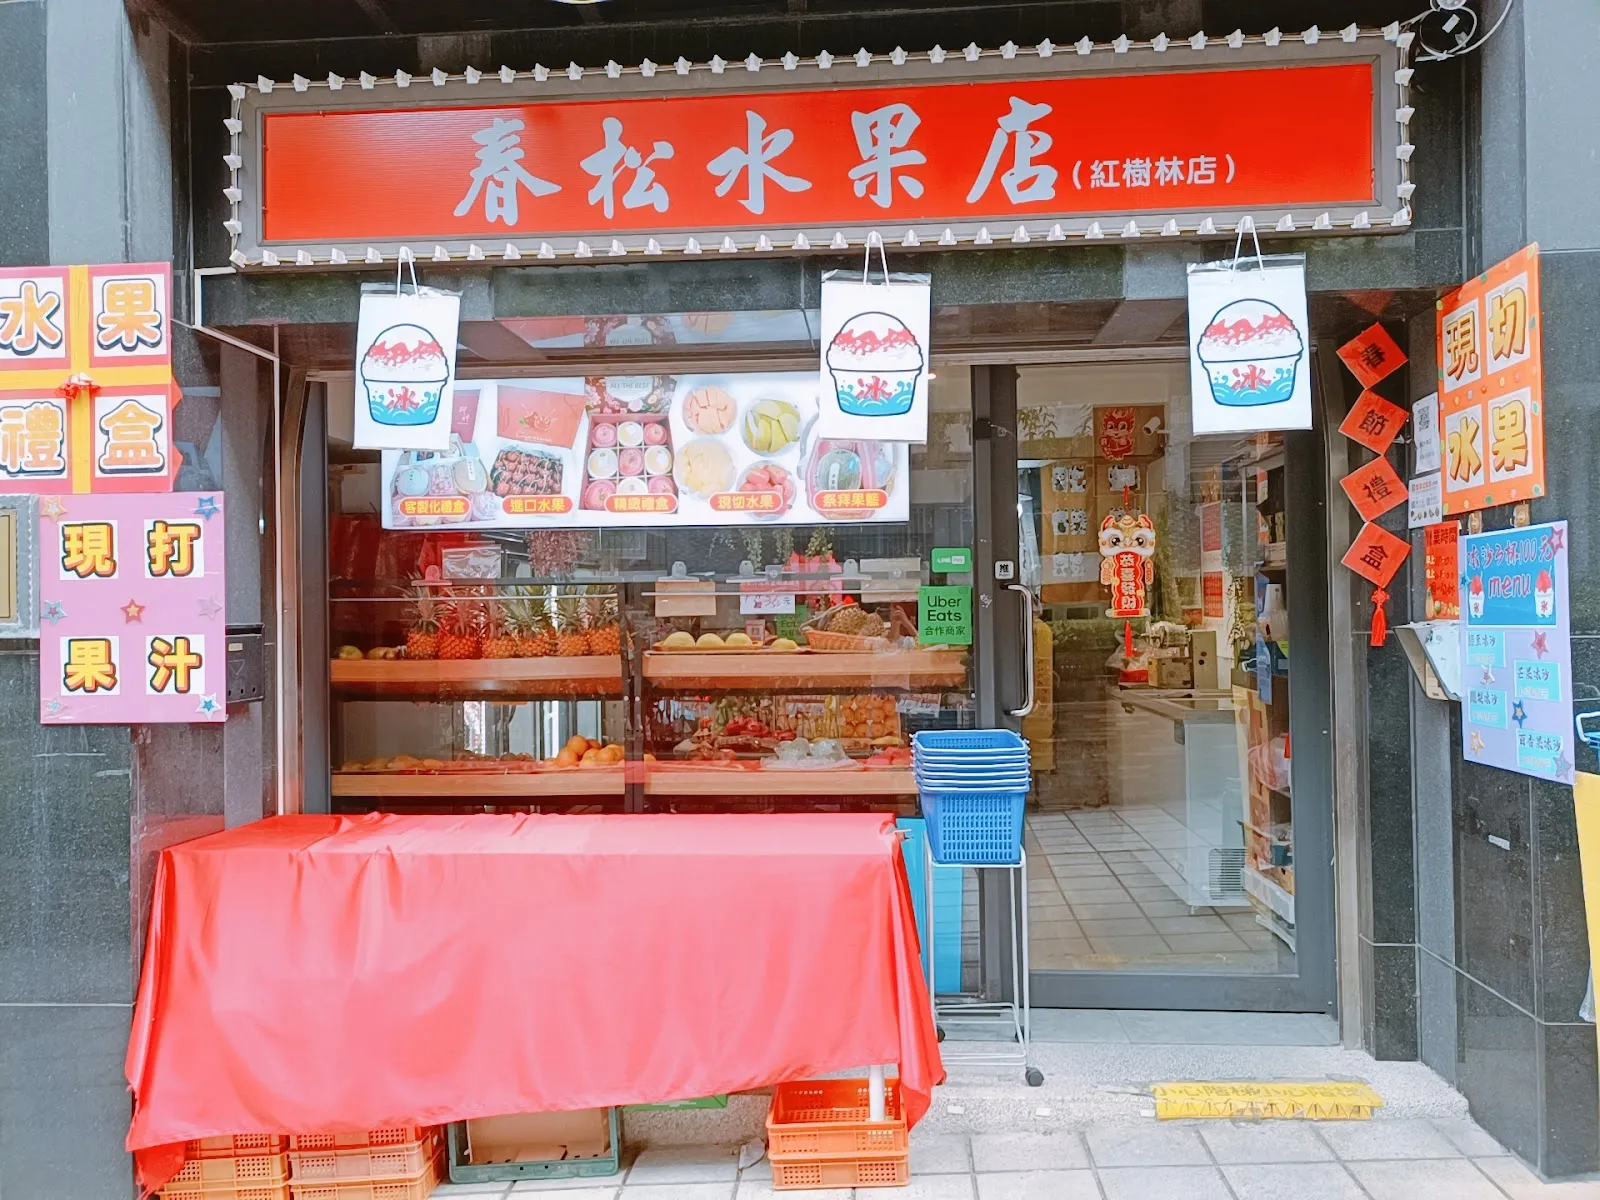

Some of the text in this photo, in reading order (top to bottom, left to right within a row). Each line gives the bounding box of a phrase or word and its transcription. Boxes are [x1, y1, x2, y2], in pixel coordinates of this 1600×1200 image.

[453, 97, 1057, 226] 春松水果店
[1071, 153, 1236, 190] (紅樹林店)
[0, 277, 161, 354] 水果
[1446, 287, 1527, 381] 現切
[855, 376, 892, 401] 冰
[1231, 364, 1271, 391] 冰
[386, 386, 419, 411] 冰
[0, 399, 163, 476] 禮盒
[1448, 400, 1528, 483] 水果
[404, 498, 465, 514] 客製化禮盒
[509, 498, 566, 513] 進口水果
[718, 494, 774, 510] 現切水果
[61, 520, 200, 577] 現打
[1488, 573, 1532, 600] menu
[927, 595, 962, 608] Uber
[927, 610, 962, 622] Eats
[925, 626, 966, 636] 合作商家
[64, 637, 202, 694] 果汁
